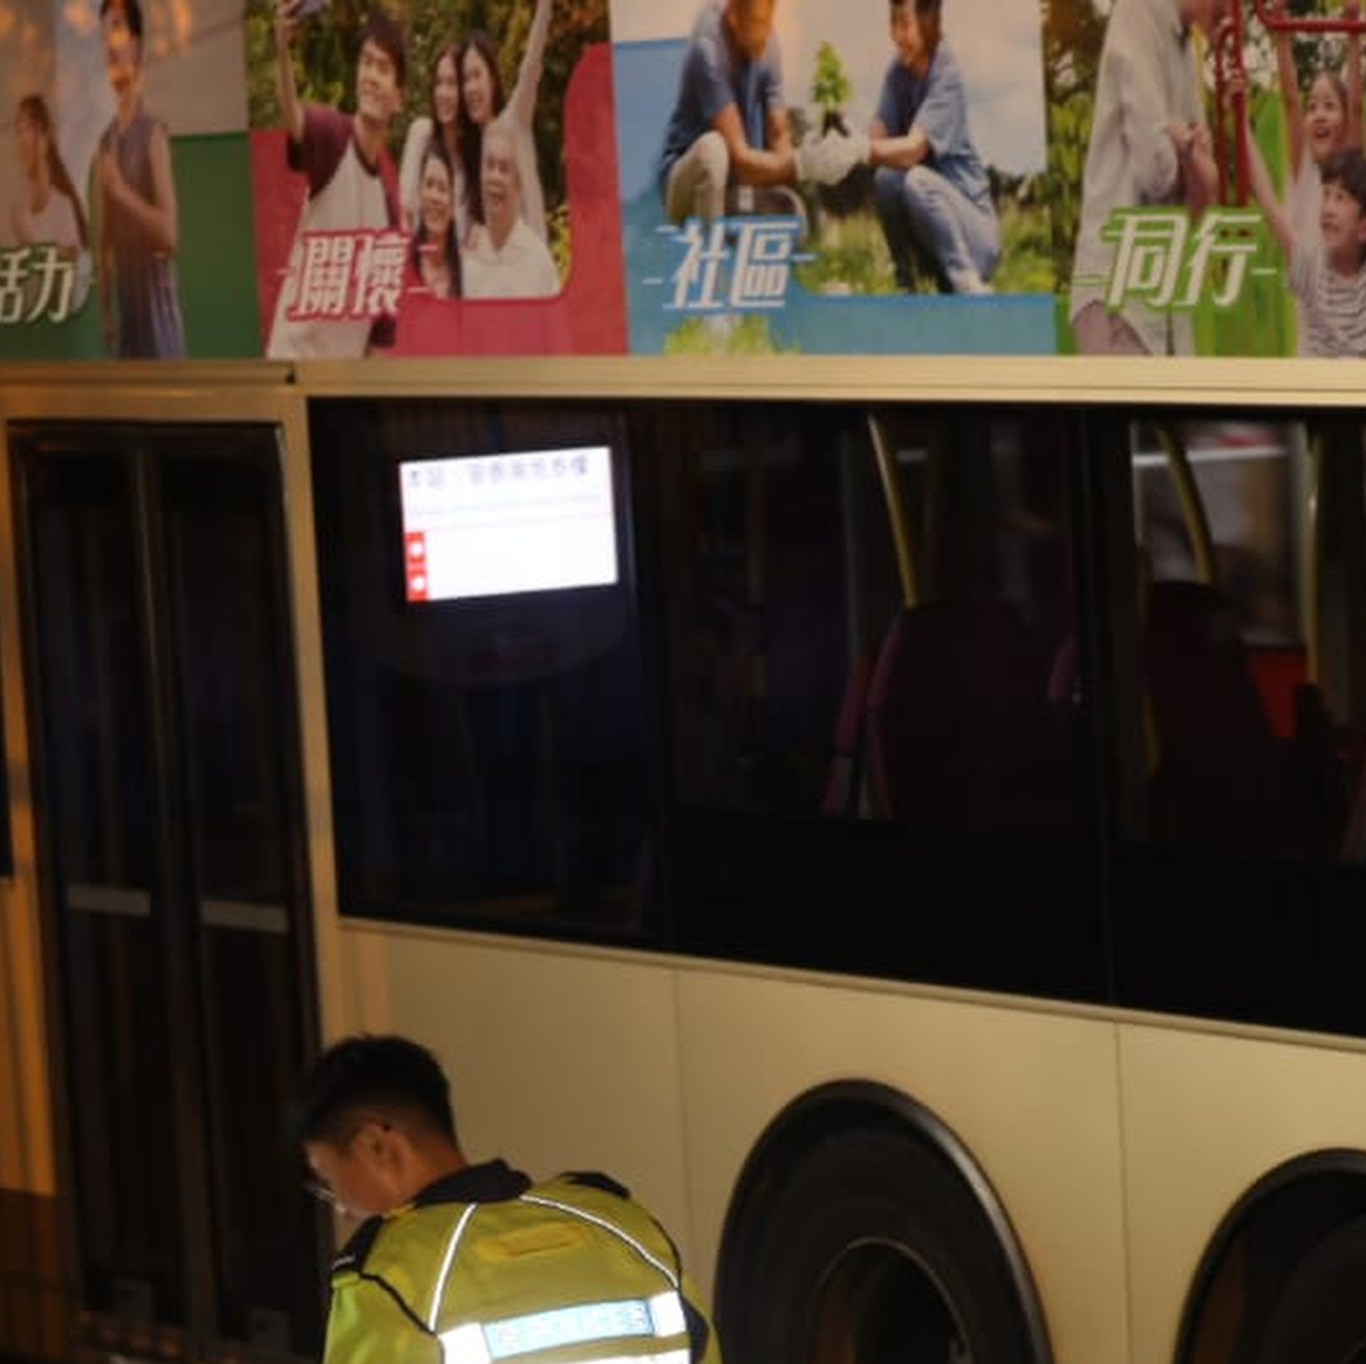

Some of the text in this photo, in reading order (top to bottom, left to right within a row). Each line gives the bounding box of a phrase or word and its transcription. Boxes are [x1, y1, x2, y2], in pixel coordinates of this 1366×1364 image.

[292, 233, 411, 317] 關懷
[663, 220, 799, 309] 社區
[1102, 213, 1261, 307] 同行
